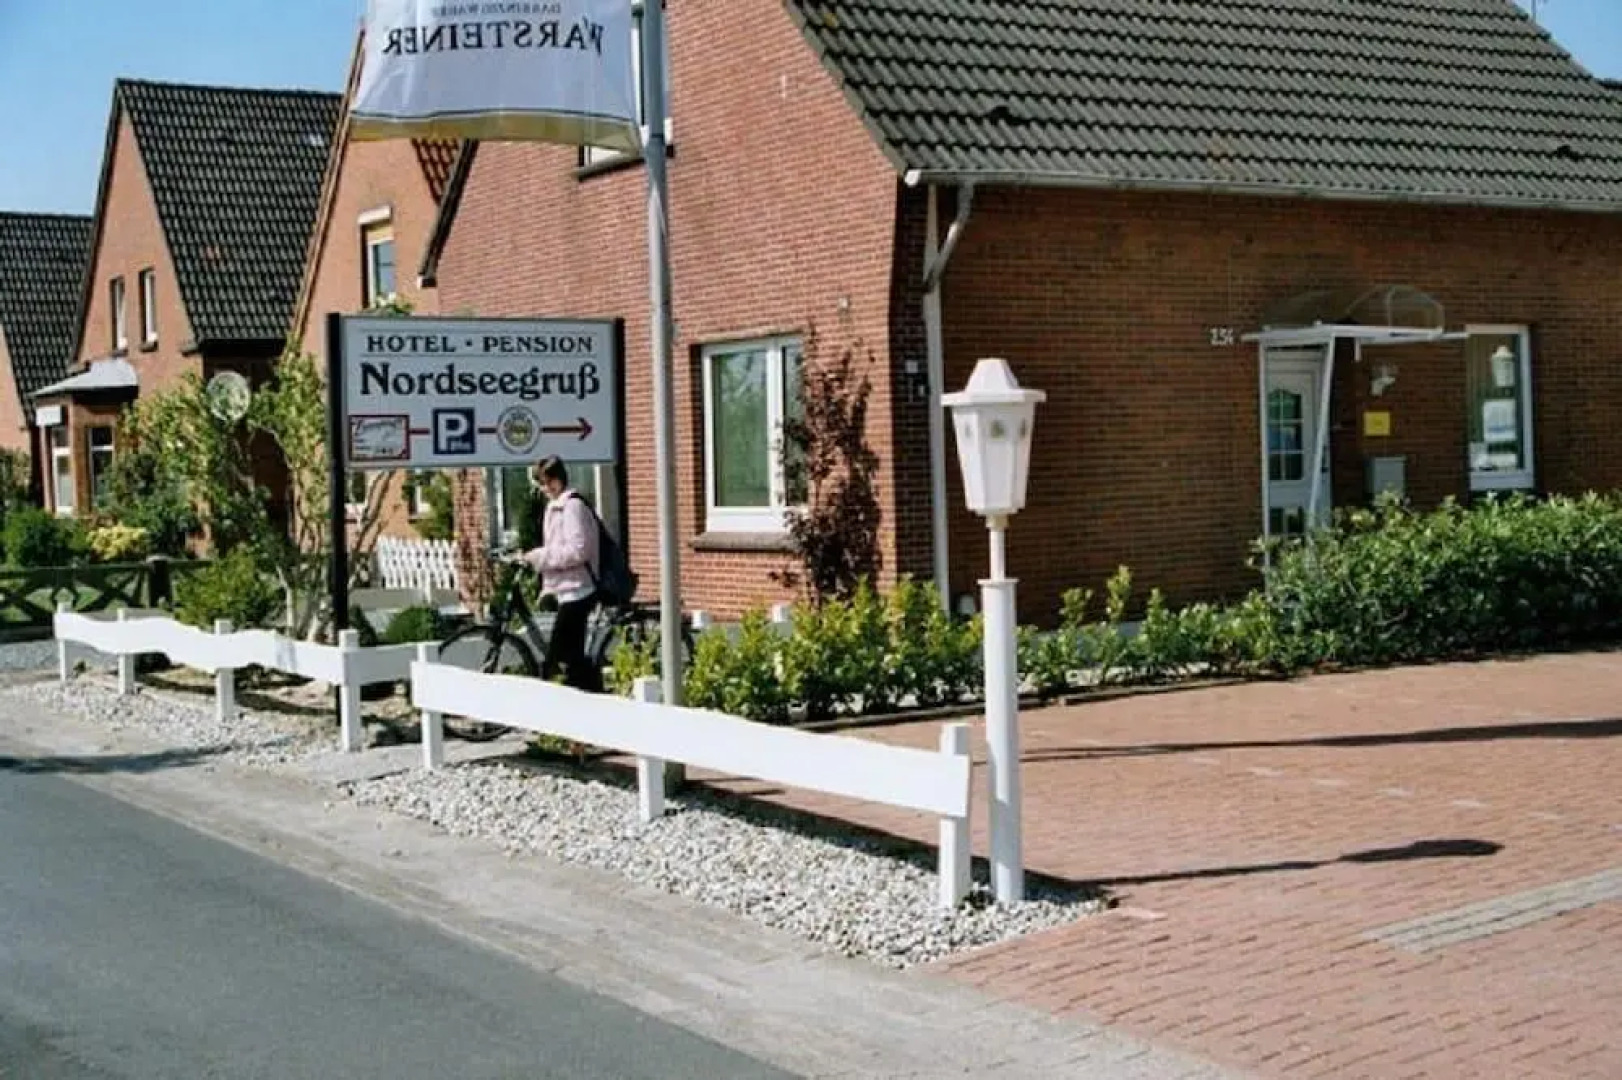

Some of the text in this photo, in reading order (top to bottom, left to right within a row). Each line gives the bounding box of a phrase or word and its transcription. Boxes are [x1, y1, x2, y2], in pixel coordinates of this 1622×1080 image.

[367, 335, 593, 352] HOTEL PENSION
[360, 362, 599, 399] Nordseegruß
[438, 412, 468, 451] P
